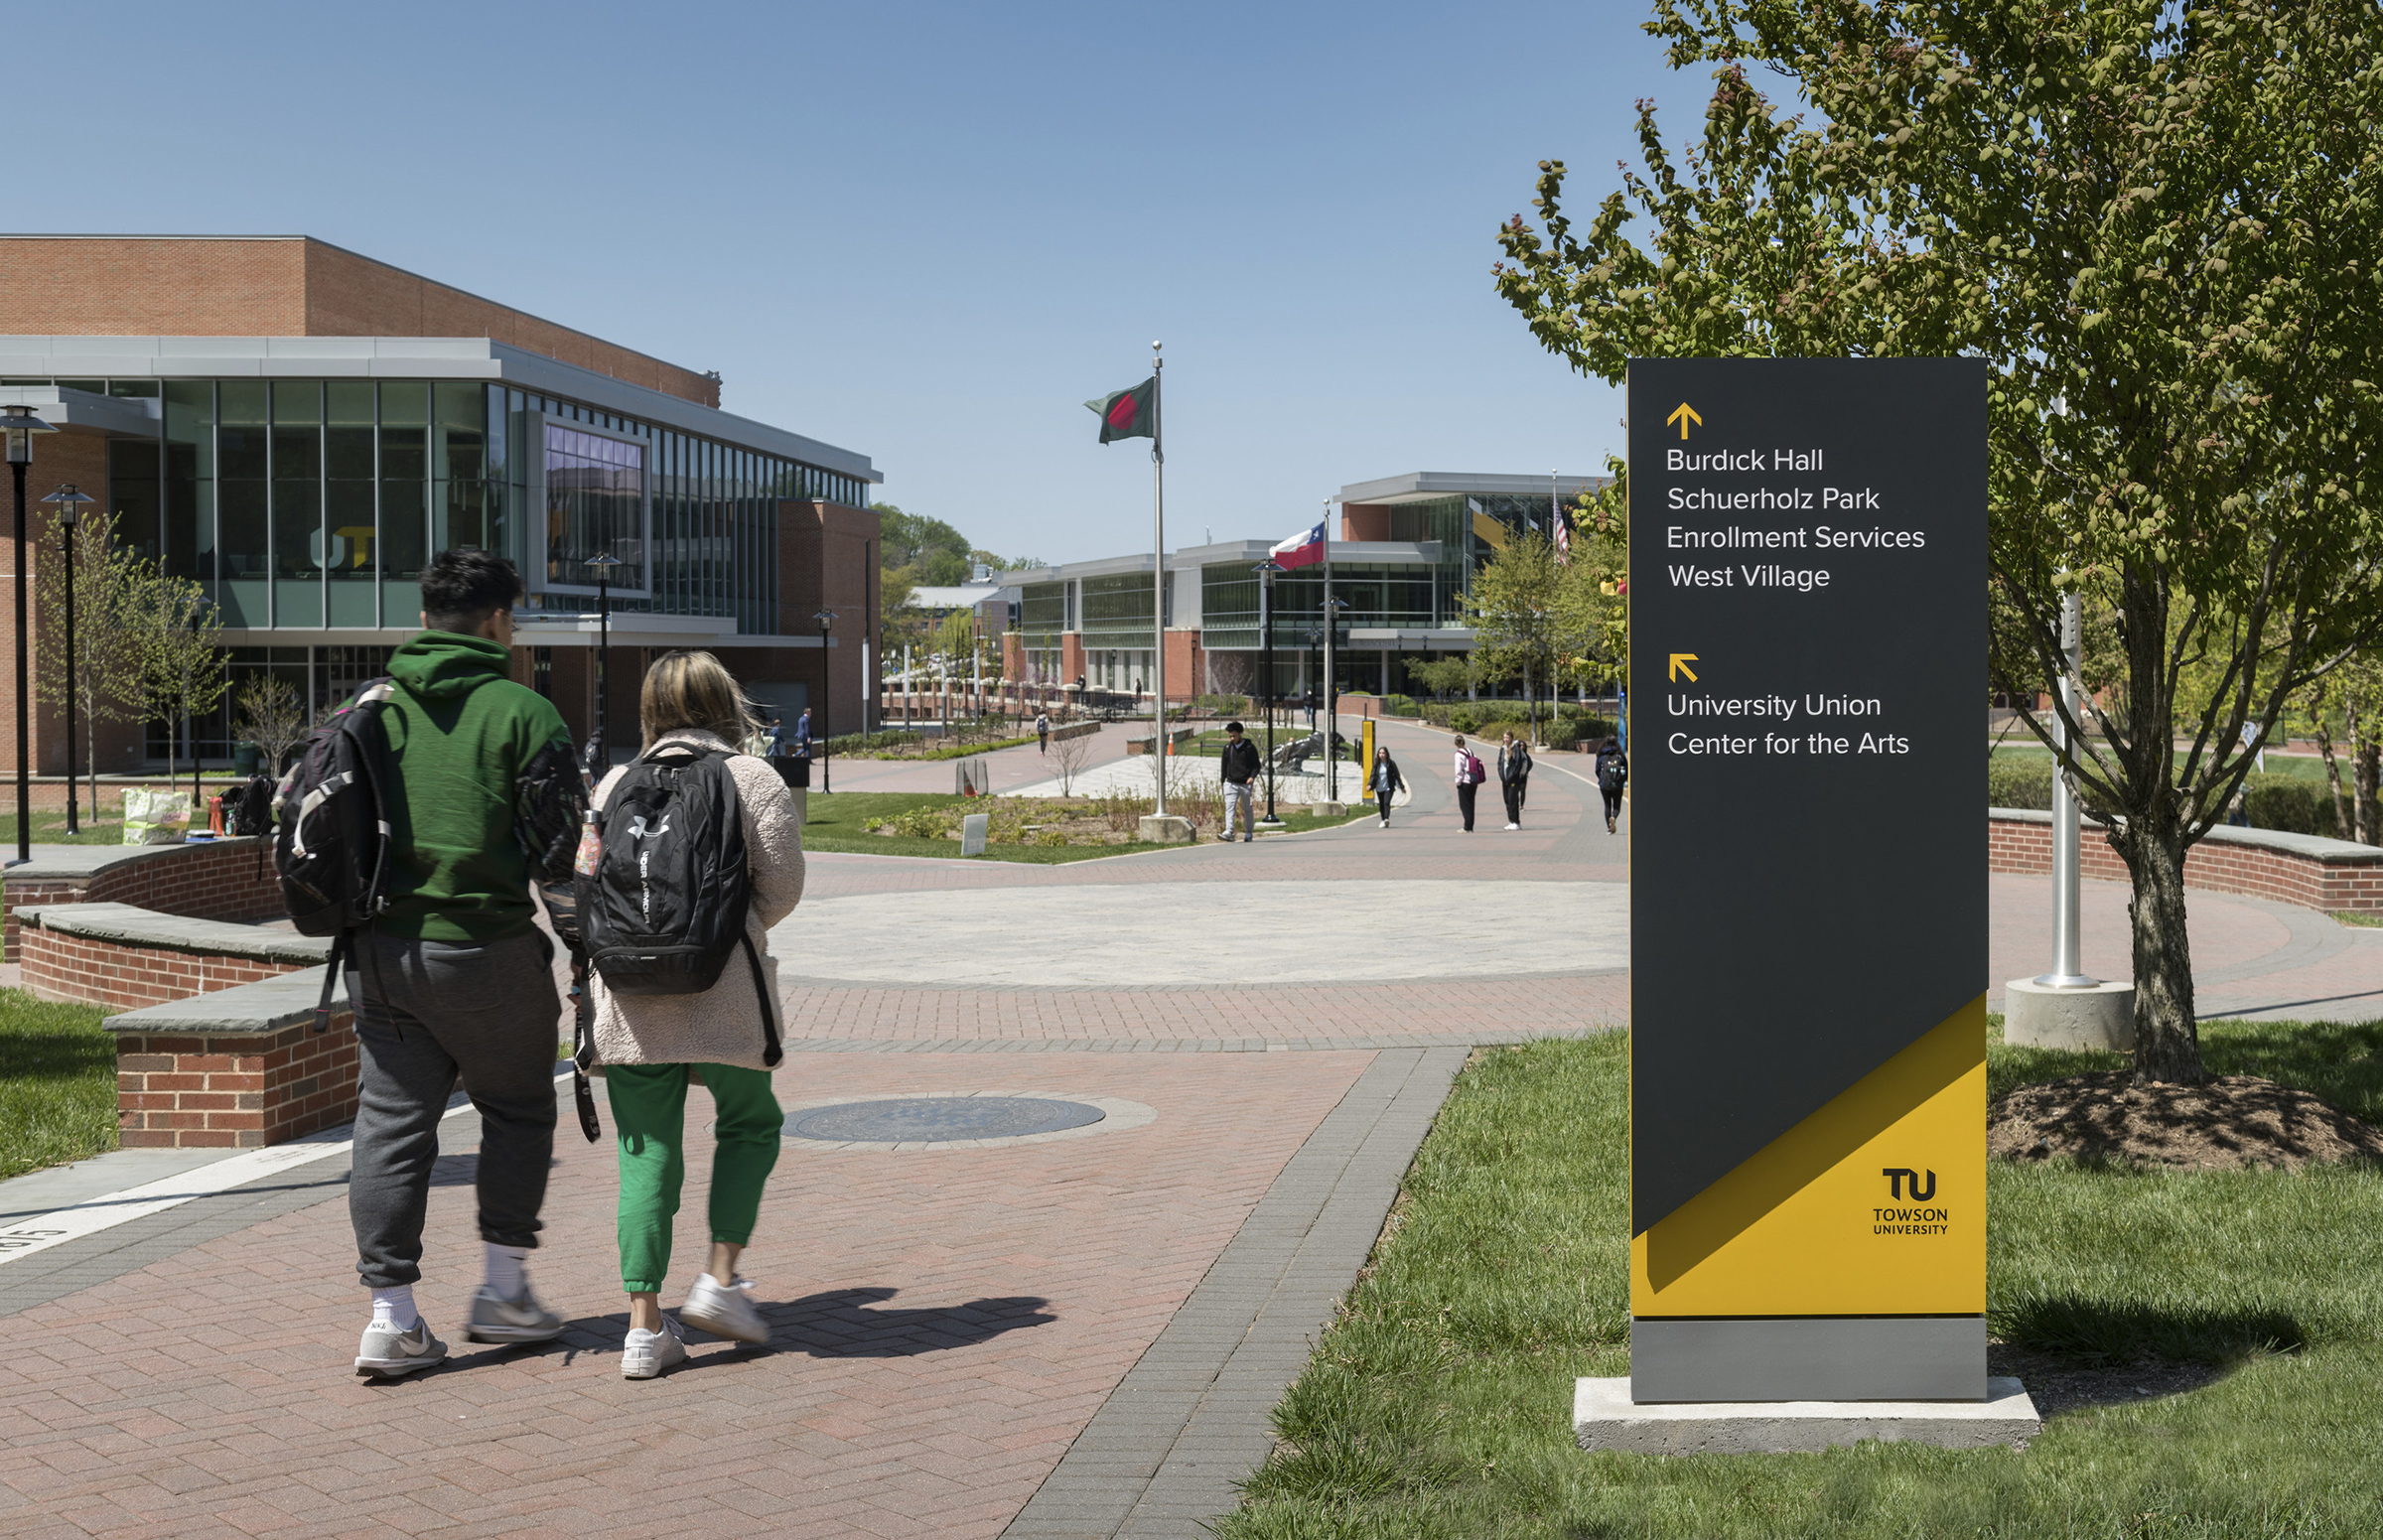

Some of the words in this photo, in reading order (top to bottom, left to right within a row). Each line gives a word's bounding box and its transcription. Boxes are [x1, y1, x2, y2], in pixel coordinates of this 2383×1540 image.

[1667, 449, 1765, 471] Burdick
[1774, 449, 1823, 471] Hall
[1668, 488, 1814, 509] Schuerholz
[1823, 488, 1880, 509] Park
[1667, 526, 1807, 548] Enrollment
[1814, 526, 1925, 548] Services
[1668, 564, 1734, 587] West
[1742, 564, 1830, 592] Village
[1668, 694, 1797, 722] University
[1805, 694, 1881, 716] Union
[1668, 733, 1756, 755] Center
[1764, 733, 1800, 755] for
[1807, 733, 1850, 755] the
[1857, 733, 1909, 755] Arts
[640, 880, 650, 924] ARMOUR
[1883, 1168, 1936, 1201] TU
[1873, 1208, 1947, 1221] TOWSON
[1874, 1224, 1948, 1235] UNIVERSITY
